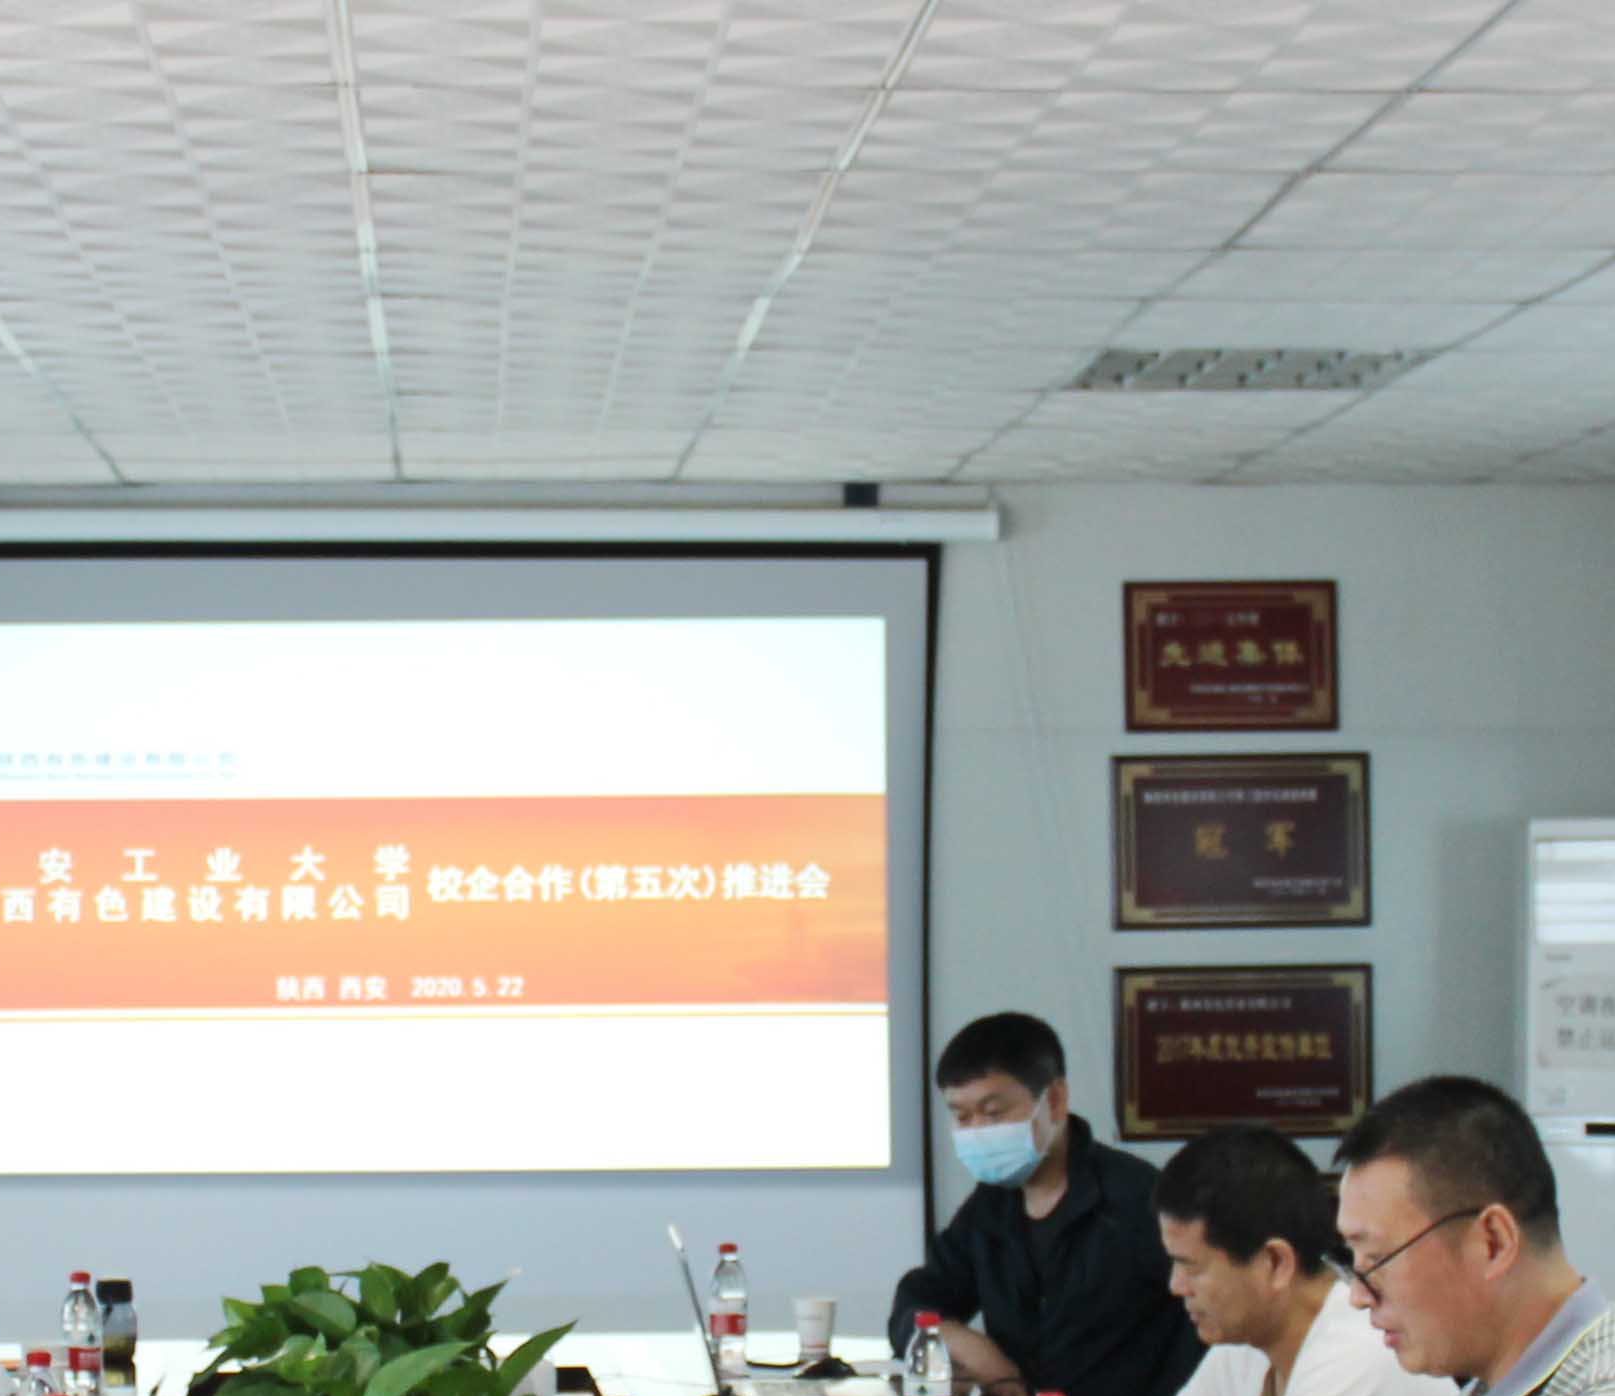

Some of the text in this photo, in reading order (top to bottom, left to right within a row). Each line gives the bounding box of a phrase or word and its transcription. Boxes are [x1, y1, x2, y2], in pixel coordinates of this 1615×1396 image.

[1160, 640, 1305, 667] 先进集体
[427, 863, 831, 902] 校企合作(第五次)推进会
[276, 976, 325, 1000] 陕西
[339, 976, 387, 1000] 西安
